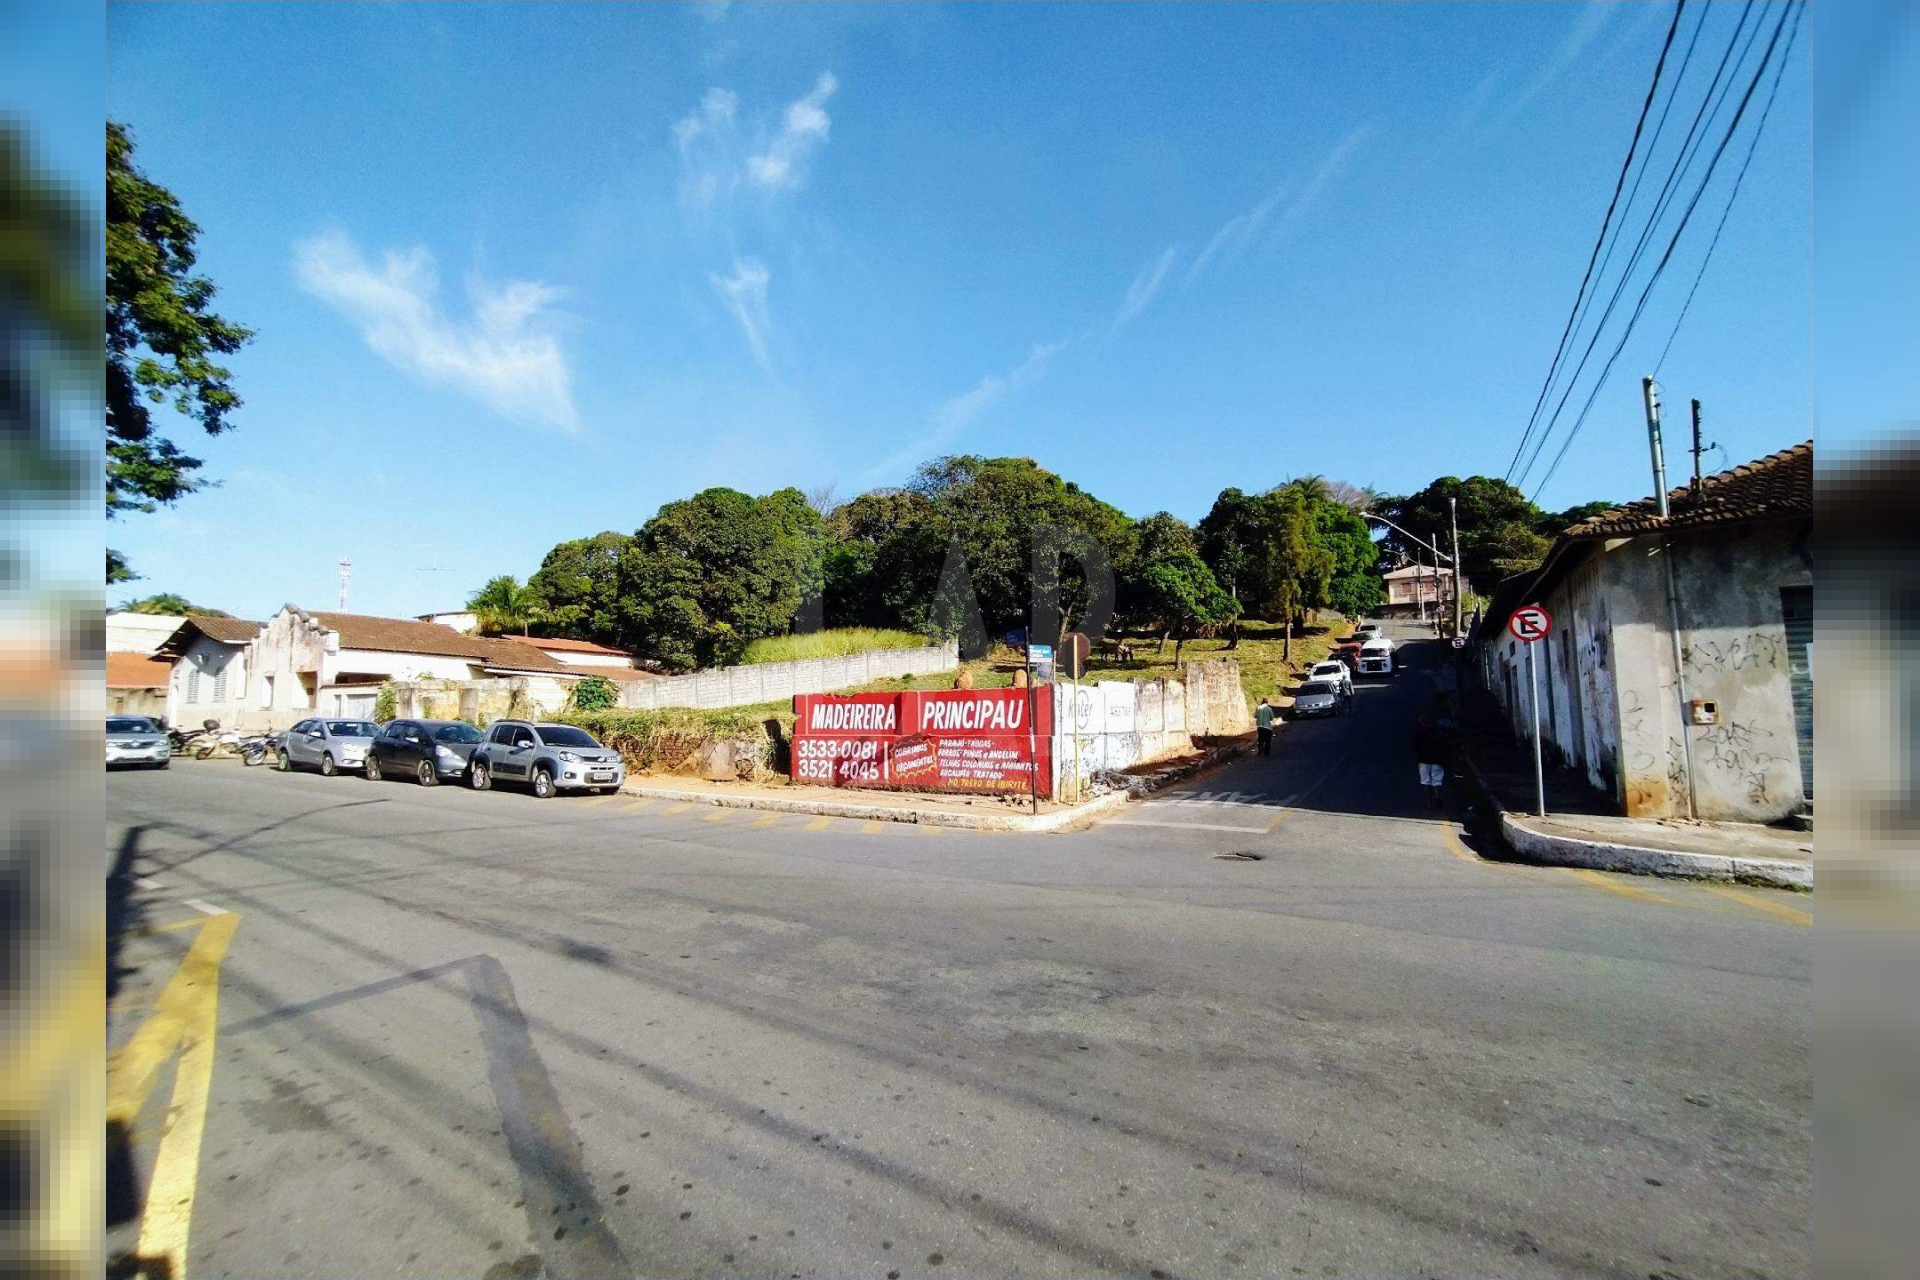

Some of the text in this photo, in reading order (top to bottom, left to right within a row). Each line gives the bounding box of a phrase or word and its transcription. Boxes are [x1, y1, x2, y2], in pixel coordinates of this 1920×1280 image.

[811, 699, 1024, 730] MADEIREIRA PRINCIPAU
[798, 740, 878, 759] 3533-0081
[798, 759, 879, 779] 3521-4045
[961, 779, 982, 787] TREVO
[986, 780, 996, 788] DE
